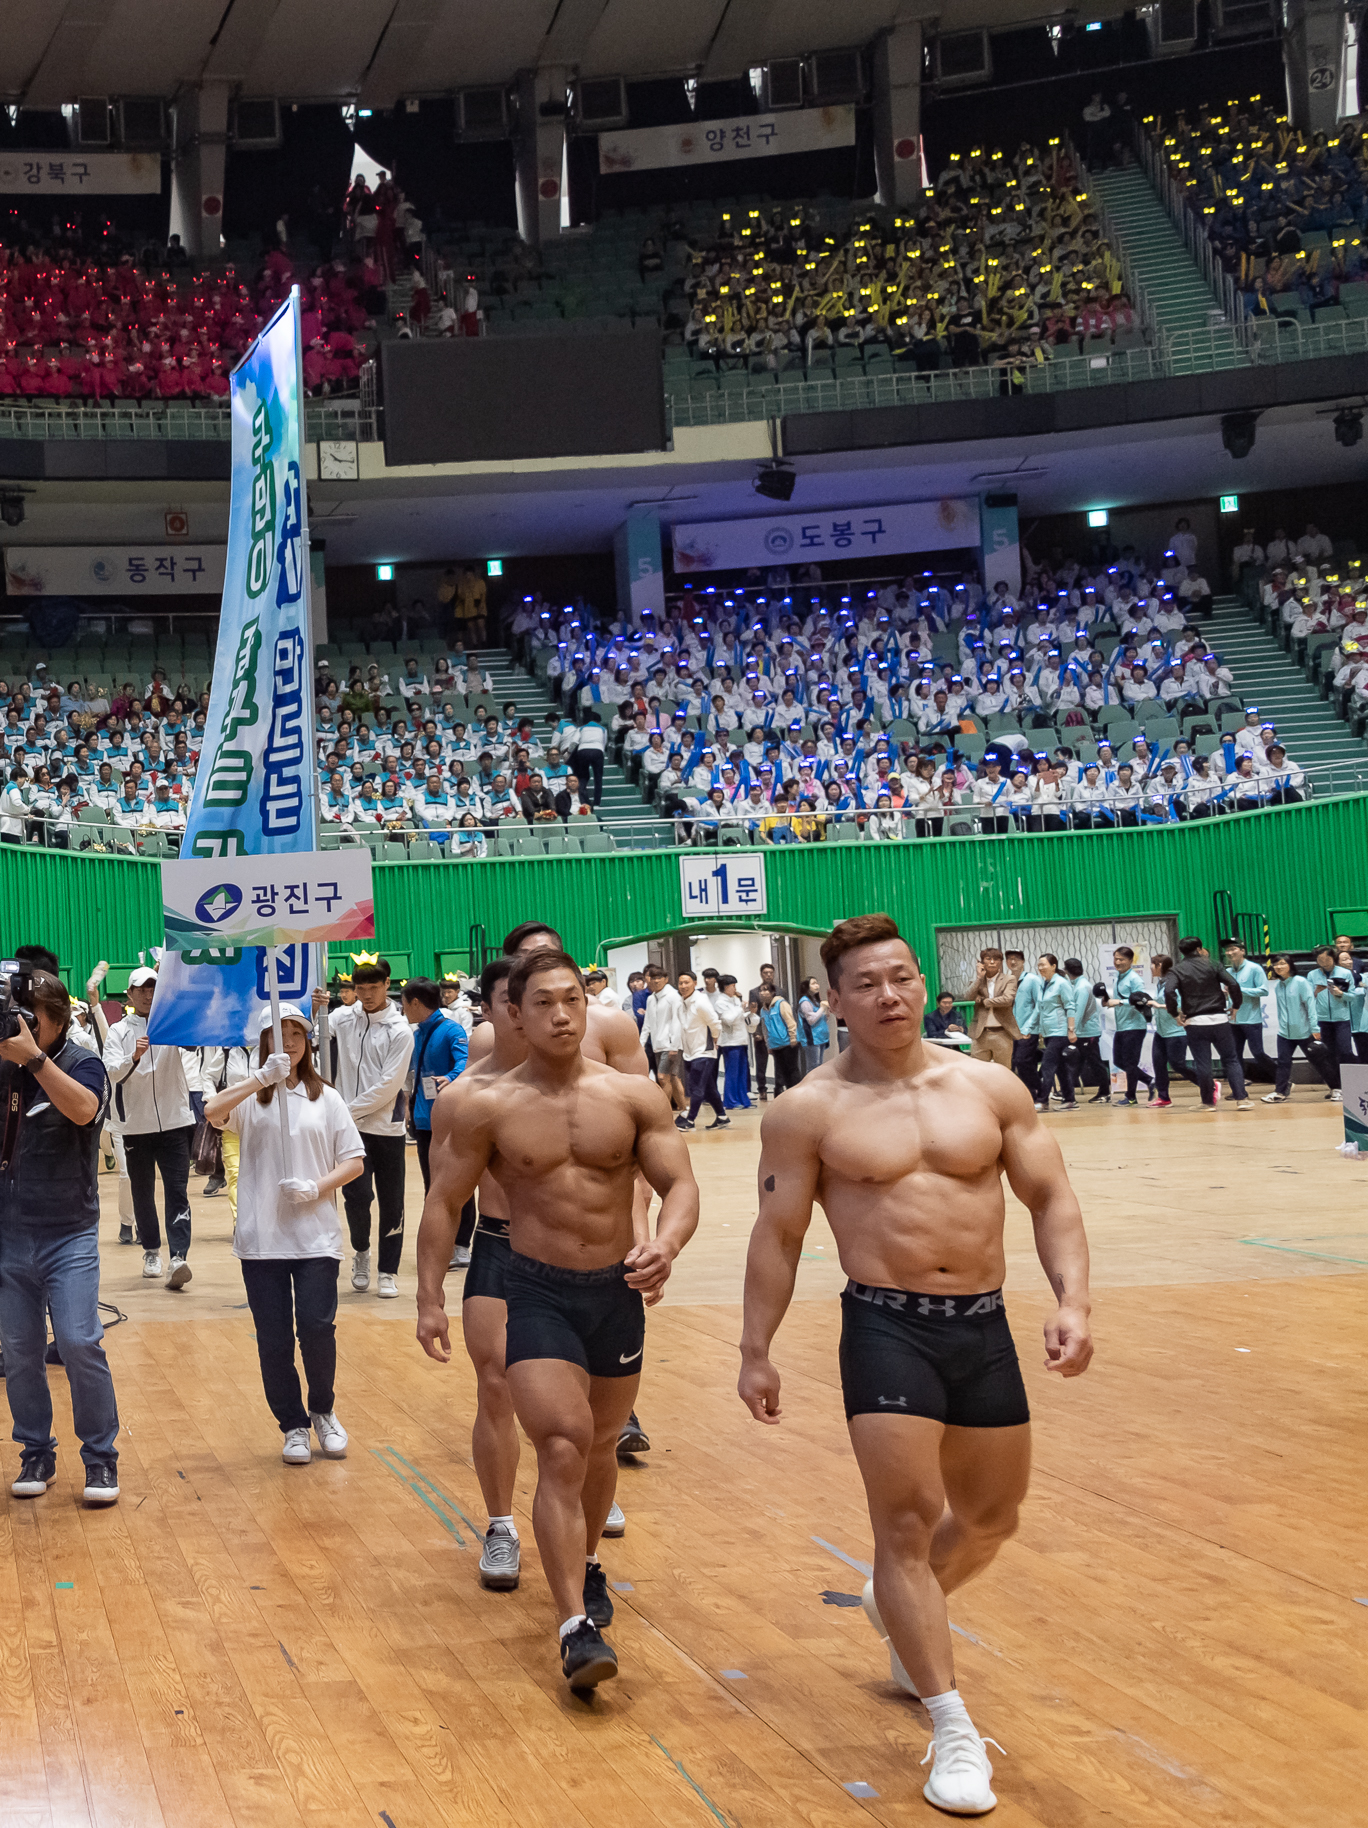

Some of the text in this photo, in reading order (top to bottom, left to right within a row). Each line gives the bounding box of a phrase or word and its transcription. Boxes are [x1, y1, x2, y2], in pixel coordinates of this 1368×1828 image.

[1312, 70, 1331, 87] 24
[705, 122, 779, 152] 양천구
[22, 161, 91, 185] 강북구
[799, 518, 887, 549] 도봉구
[992, 528, 1009, 550] 5
[125, 555, 206, 584] 동작구
[638, 558, 653, 576] 5
[250, 881, 343, 918] 광진구
[11, 1091, 19, 1112] EOS
